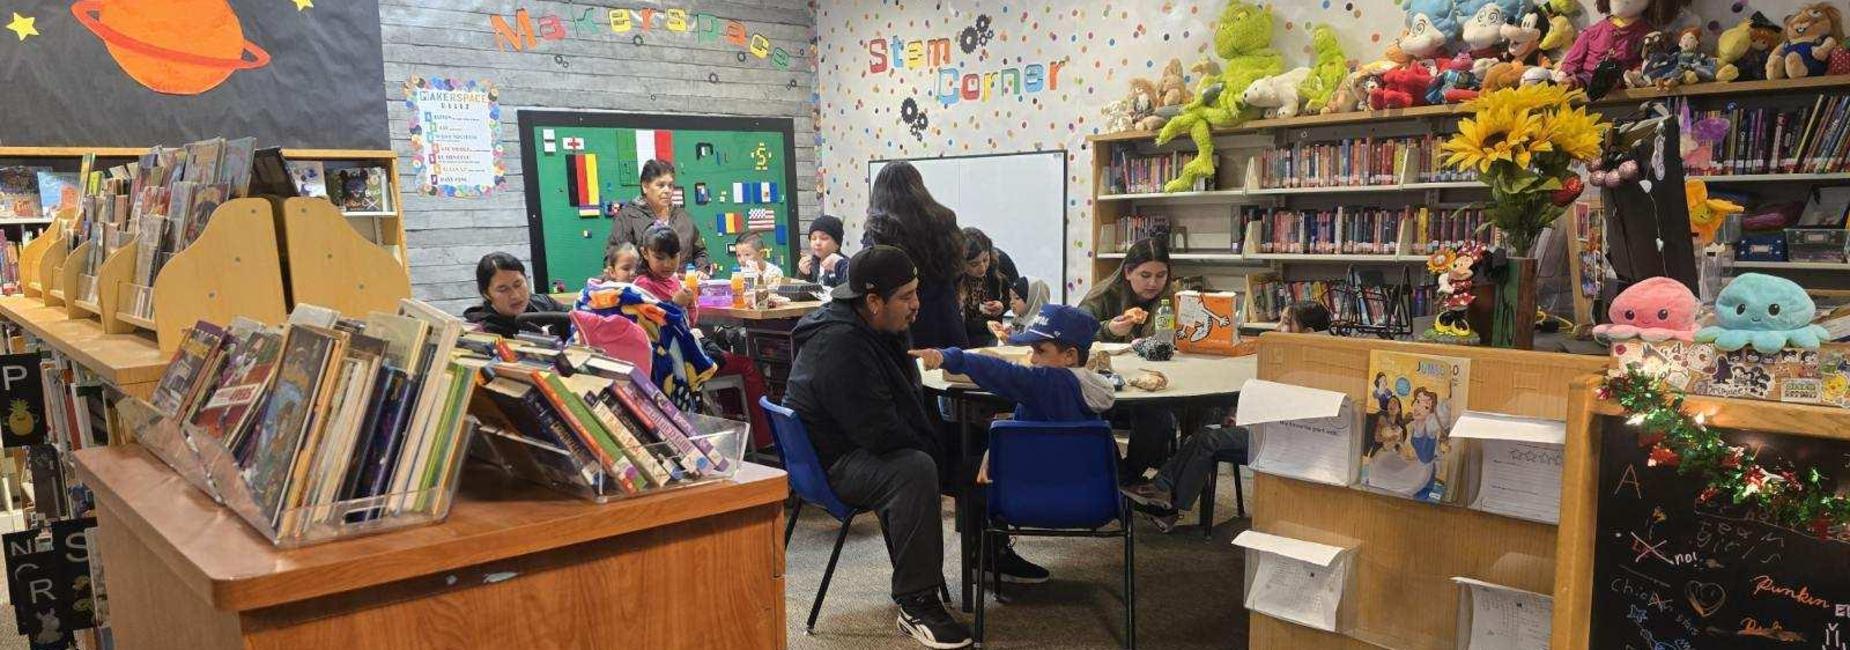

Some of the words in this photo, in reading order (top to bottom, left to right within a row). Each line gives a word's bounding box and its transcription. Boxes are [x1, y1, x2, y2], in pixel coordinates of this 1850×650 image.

[489, 7, 791, 71] Makerspace
[868, 34, 951, 74] Stem
[935, 55, 1069, 104] Corner
[2, 364, 28, 391] P
[1614, 464, 1641, 500] A
[10, 539, 32, 557] N
[65, 531, 88, 562] S
[1674, 551, 1698, 567] no!
[29, 578, 57, 604] R
